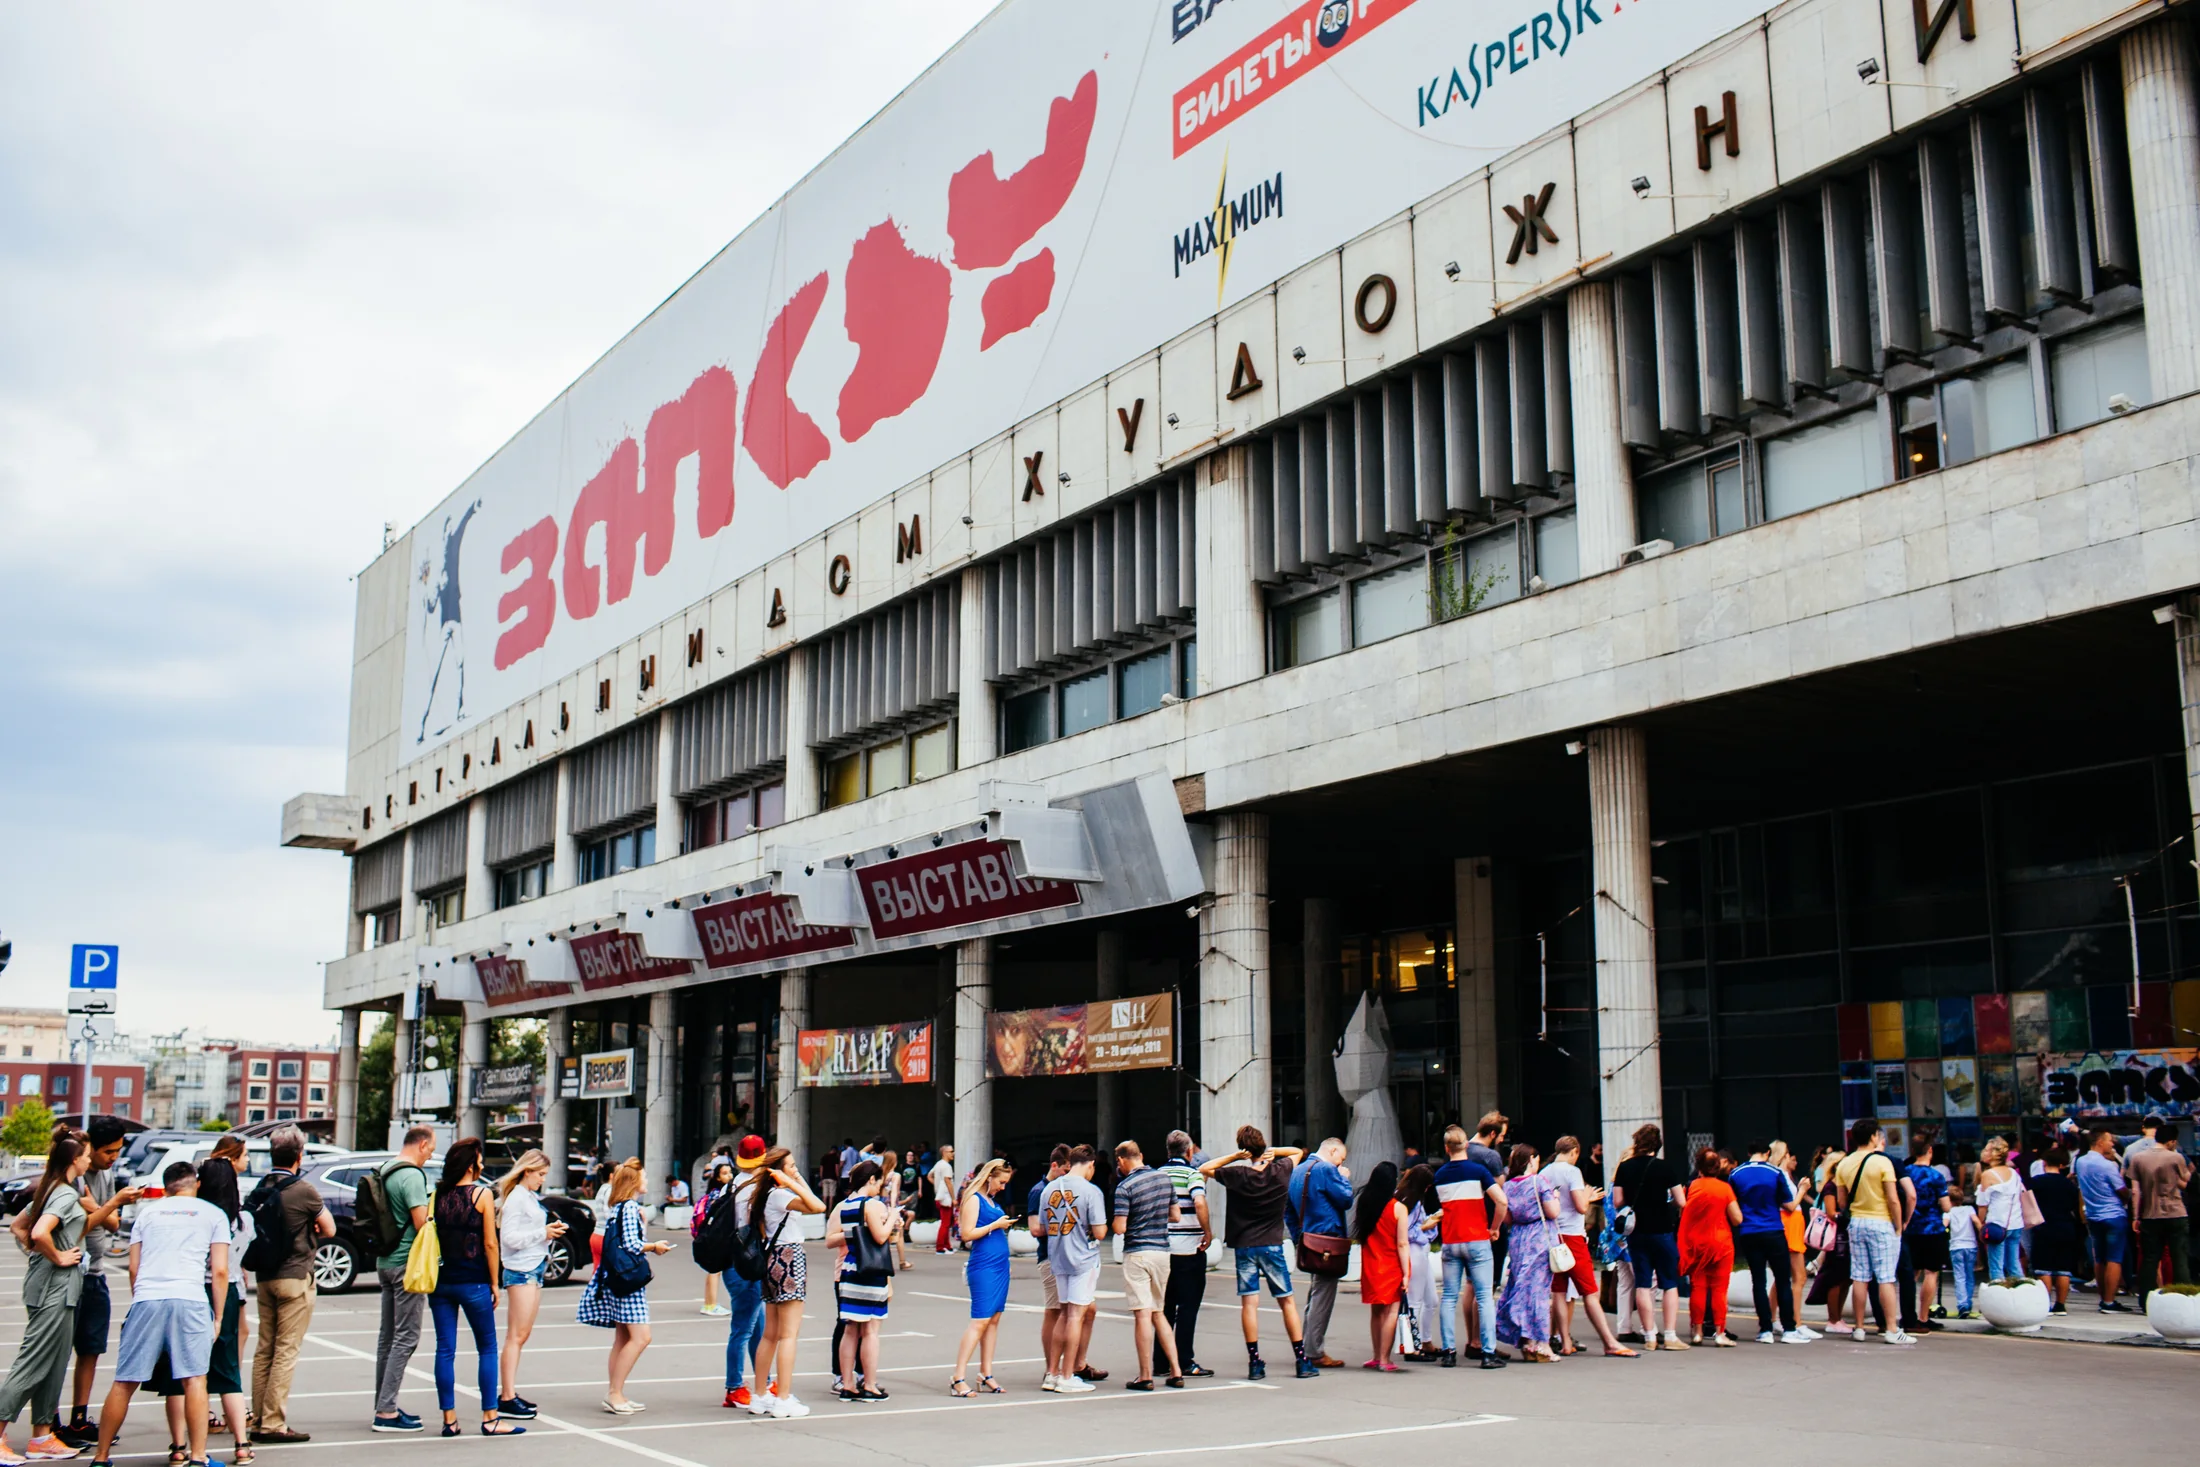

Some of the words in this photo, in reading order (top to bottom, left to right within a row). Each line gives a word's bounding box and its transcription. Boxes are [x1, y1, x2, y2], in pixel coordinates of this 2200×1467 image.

[1179, 19, 1312, 138] БИЛЕТЫ
[1418, 0, 1622, 128] KASPERSK
[1174, 170, 1283, 279] MAXIMUM
[872, 850, 1059, 923] ВЫСТАВК
